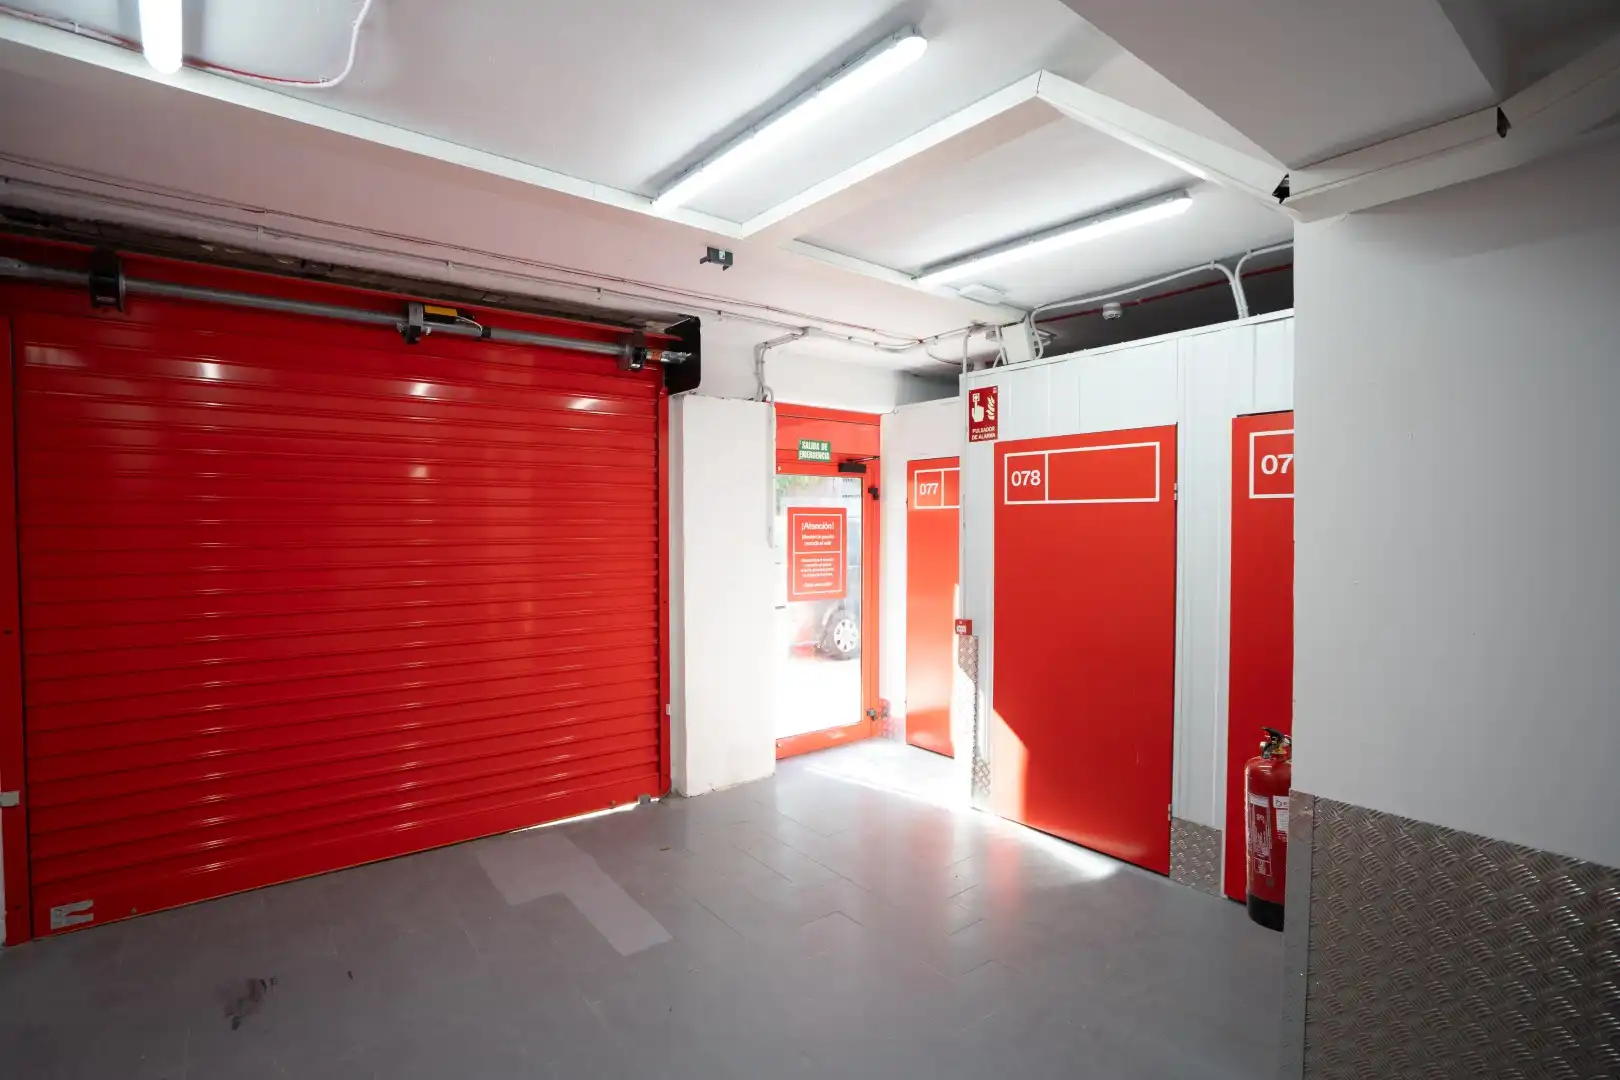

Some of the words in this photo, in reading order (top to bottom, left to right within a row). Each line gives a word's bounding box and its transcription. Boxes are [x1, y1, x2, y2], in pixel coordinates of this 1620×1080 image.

[972, 426, 995, 434] PULSADOR
[802, 441, 820, 450] SALIDA
[821, 442, 828, 451] DE
[799, 450, 830, 460] EMERGENCIA
[1261, 453, 1294, 475] 07
[1011, 469, 1041, 487] 078
[920, 482, 939, 496] 077
[802, 522, 834, 530] ¡Atención!
